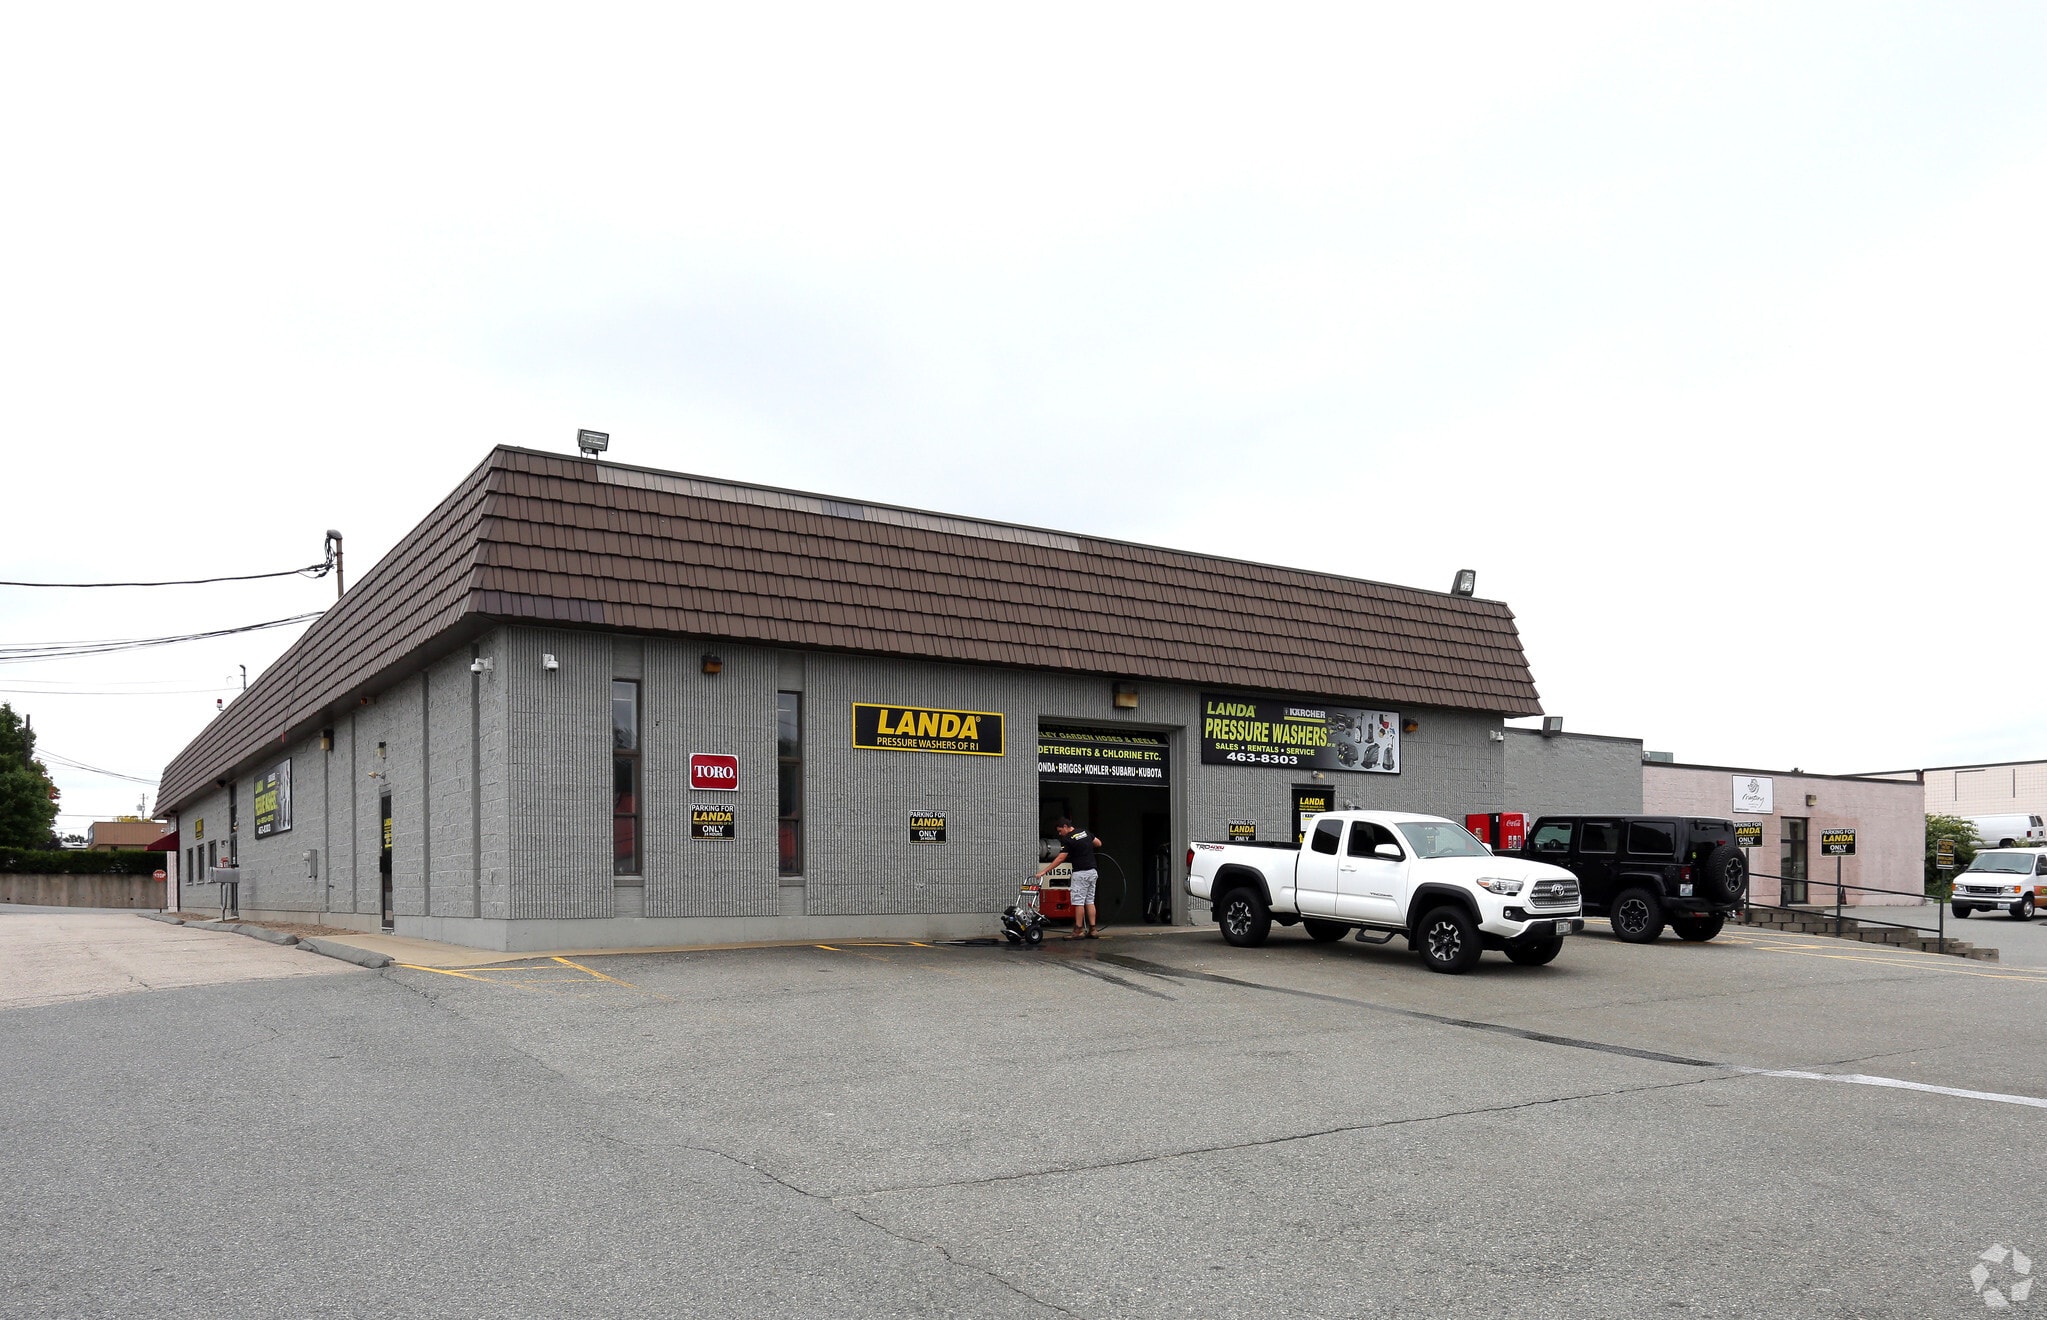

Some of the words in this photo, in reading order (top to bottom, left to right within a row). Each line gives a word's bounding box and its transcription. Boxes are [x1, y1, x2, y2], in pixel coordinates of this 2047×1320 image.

[1207, 701, 1256, 718] LANDA
[877, 709, 979, 740] LANDA
[1059, 732, 1096, 741] GARDEN
[1096, 735, 1123, 743] HOSES
[1205, 717, 1270, 743] PRESSURE
[1272, 723, 1328, 747] WASHERS
[877, 736, 918, 748] PRESSURE
[919, 740, 956, 750] WASHERS
[957, 741, 969, 750] OF
[1215, 742, 1239, 751] SALES
[1247, 744, 1279, 753] RENTALS
[1286, 747, 1315, 756] SERVICE
[1038, 745, 1092, 757] DETERGENTS
[1094, 748, 1101, 757] &
[1102, 749, 1143, 760] CHLORINE
[1144, 751, 1162, 761] ETC.
[1226, 752, 1298, 765] 463-8303
[694, 765, 734, 779] TORO
[1038, 761, 1056, 773] ONDA
[1059, 762, 1082, 774] BRIGGS
[1084, 764, 1110, 775] KOHLER
[1111, 766, 1136, 777] SUBARU
[1138, 767, 1162, 778] KUBOTA
[1299, 797, 1325, 806] LANDA
[691, 804, 720, 812] PARKING
[693, 811, 732, 821] LANDA
[911, 818, 944, 827] LANDA
[702, 825, 724, 833] ONLY
[1230, 825, 1255, 833] LANDA
[1823, 834, 1854, 842] LANDA
[1046, 868, 1073, 876] NISSA
